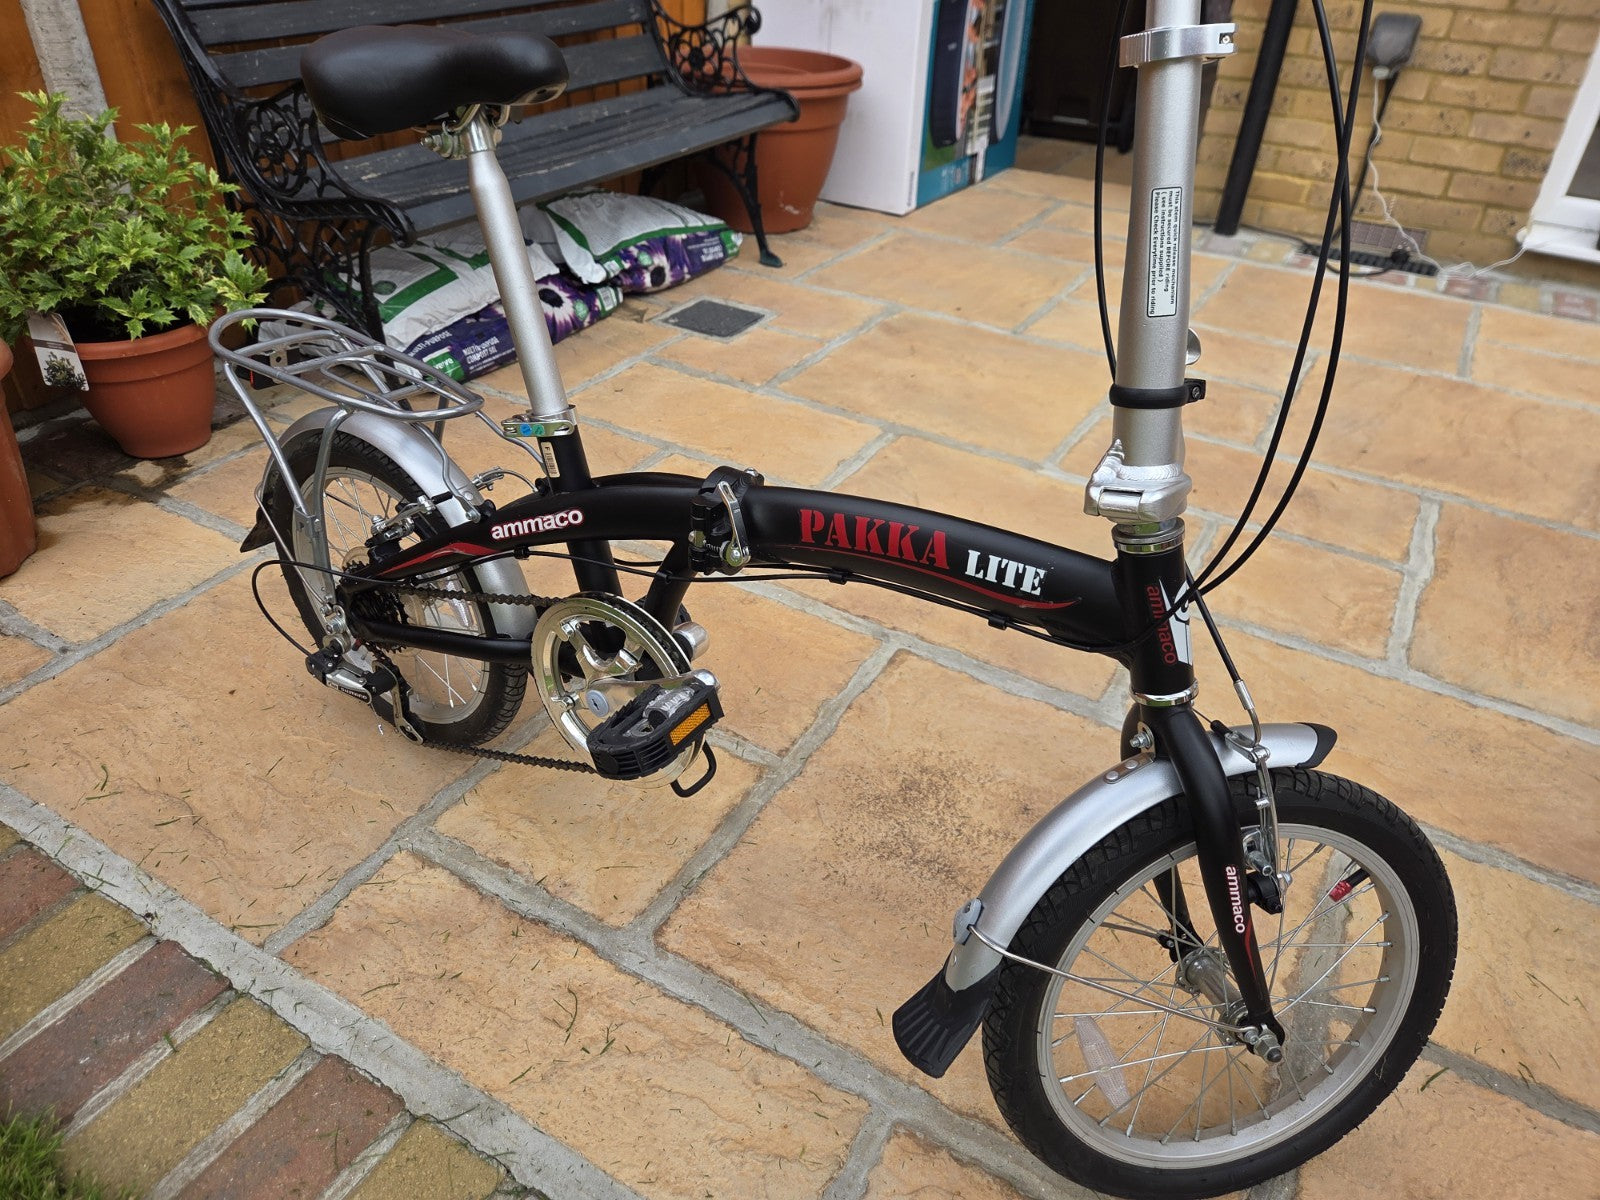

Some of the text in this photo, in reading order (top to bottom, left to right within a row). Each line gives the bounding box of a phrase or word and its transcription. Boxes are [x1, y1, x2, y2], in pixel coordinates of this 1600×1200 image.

[1151, 236, 1159, 269] Everytime
[491, 509, 584, 541] ammaco
[800, 508, 1048, 597] PAKKA LITE
[1225, 866, 1246, 934] ammaco
